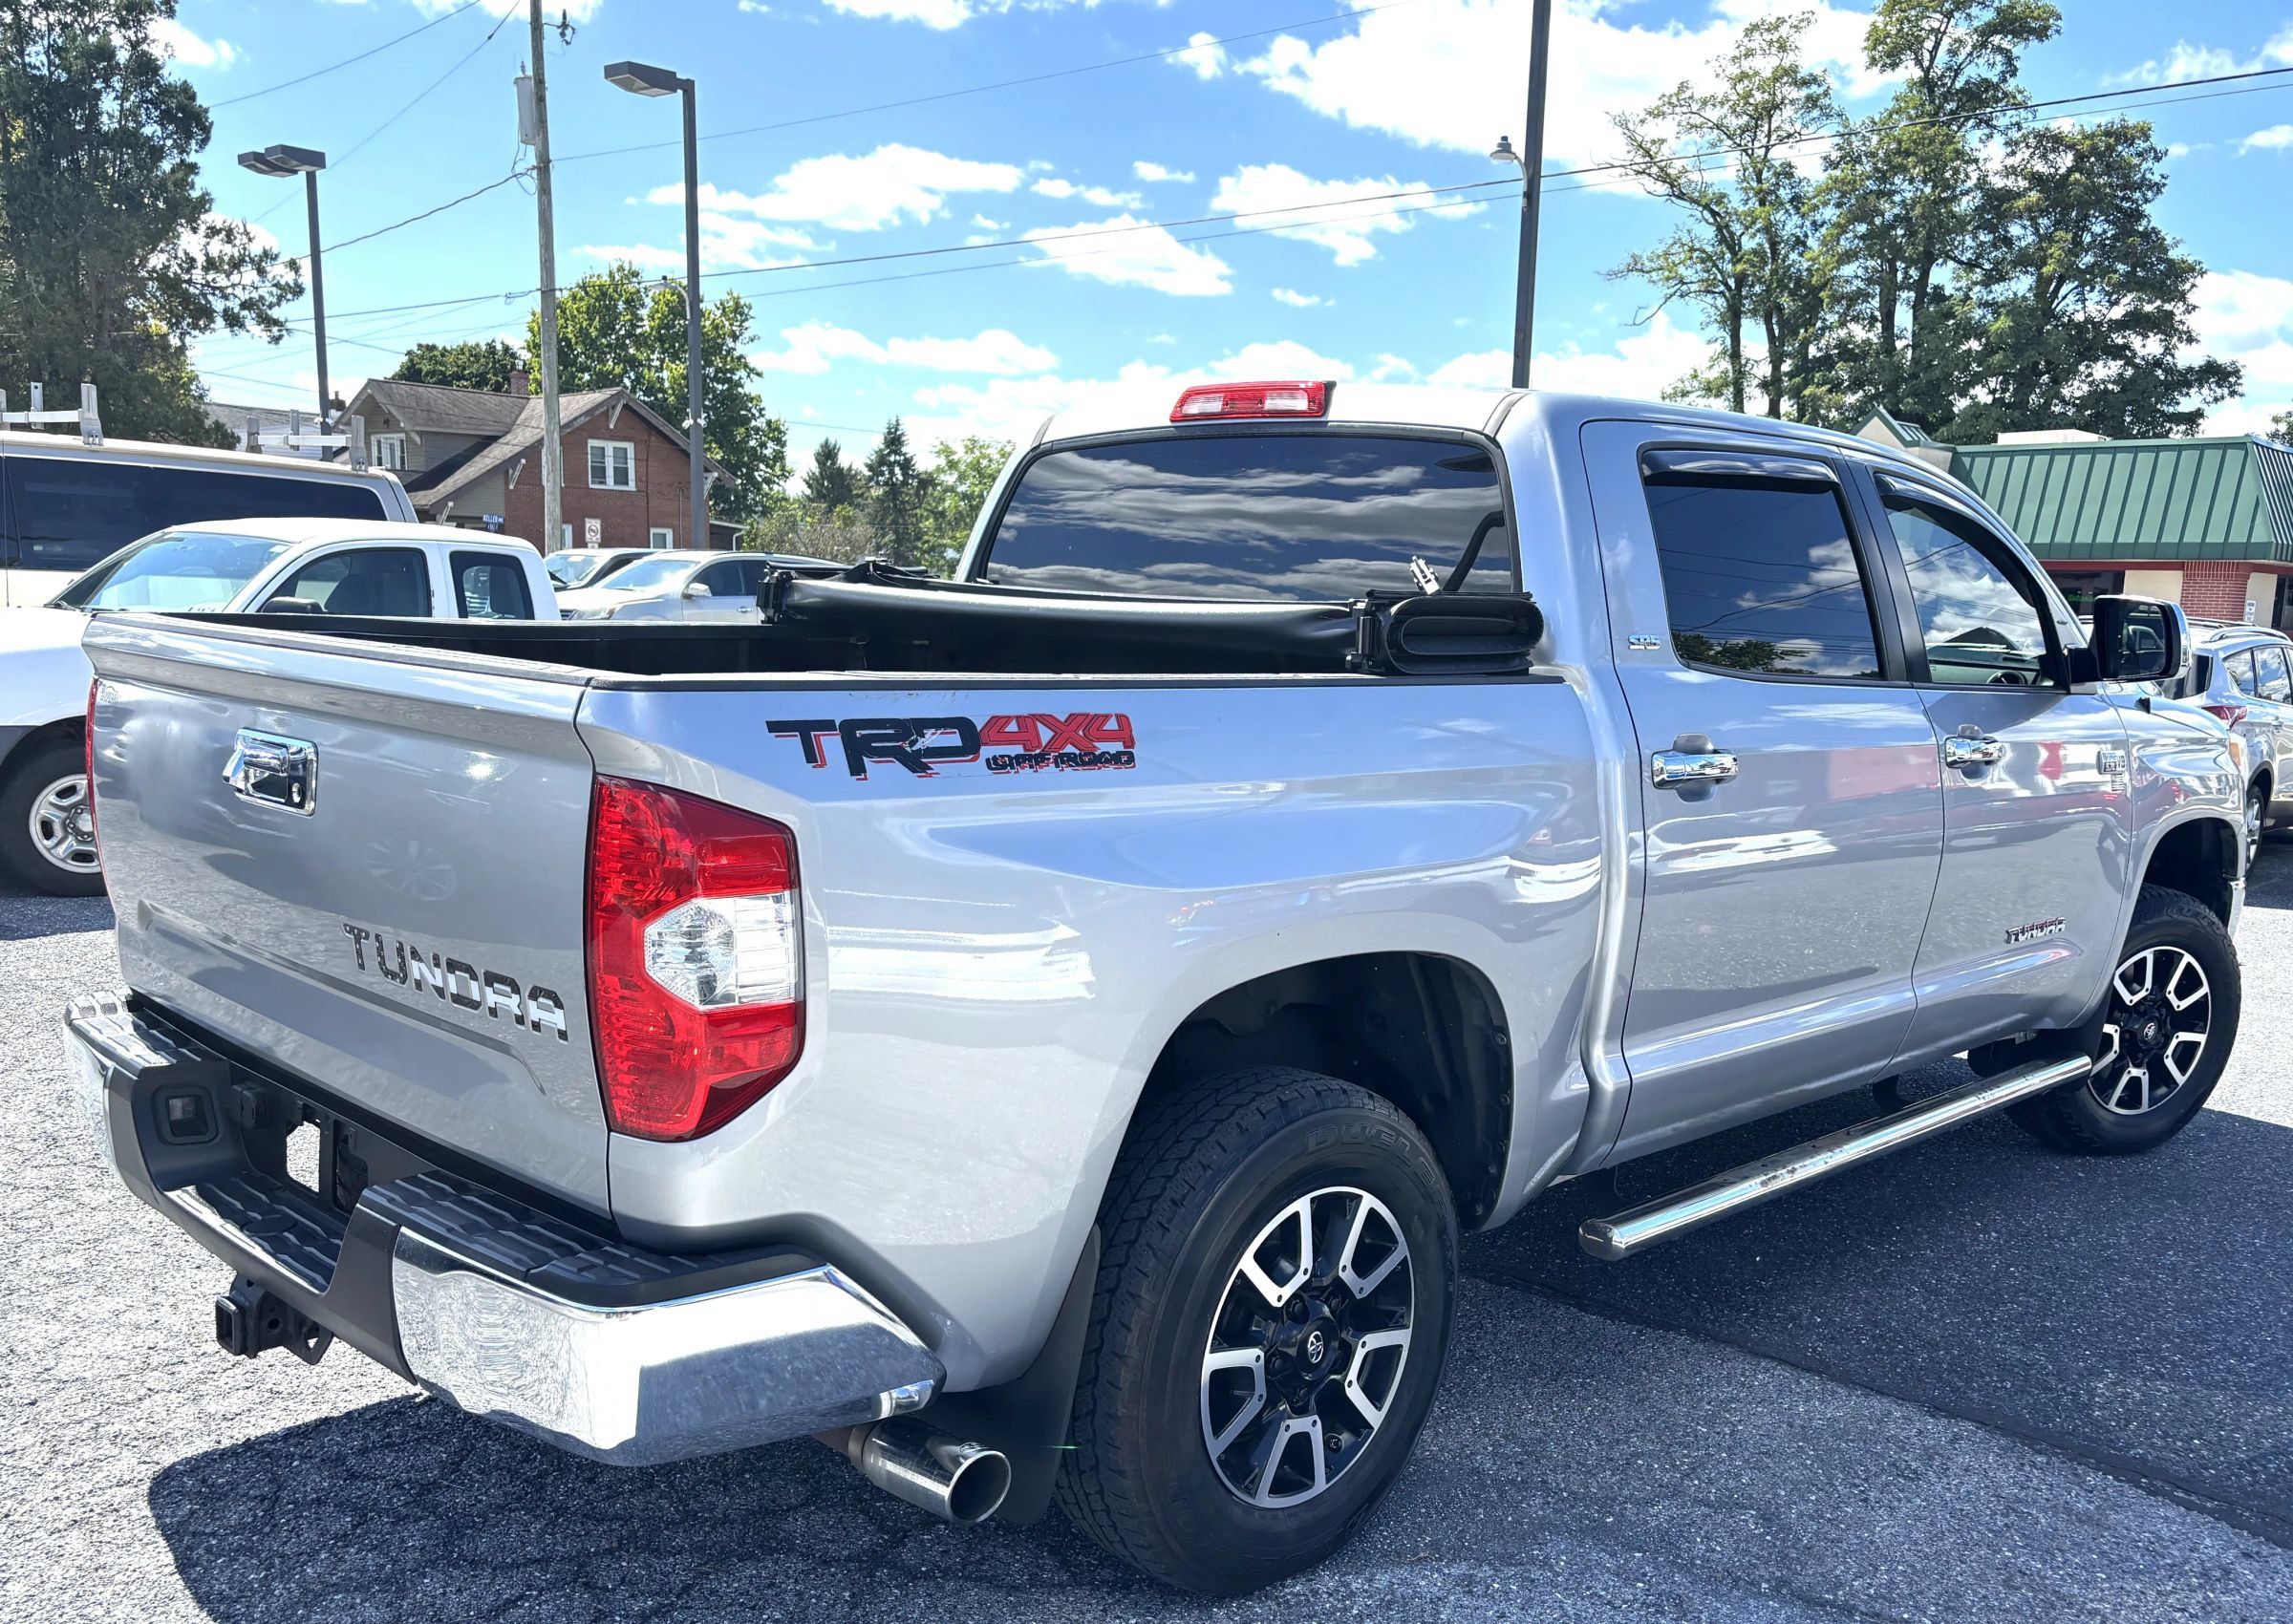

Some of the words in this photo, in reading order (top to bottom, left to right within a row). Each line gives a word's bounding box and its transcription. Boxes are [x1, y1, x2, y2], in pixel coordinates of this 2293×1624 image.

[765, 716, 981, 781] TRD
[980, 713, 1137, 753] 4X4
[1055, 750, 1137, 771] ROAD
[2004, 916, 2067, 945] TUNDRA
[341, 922, 569, 1044] TUNDRA
